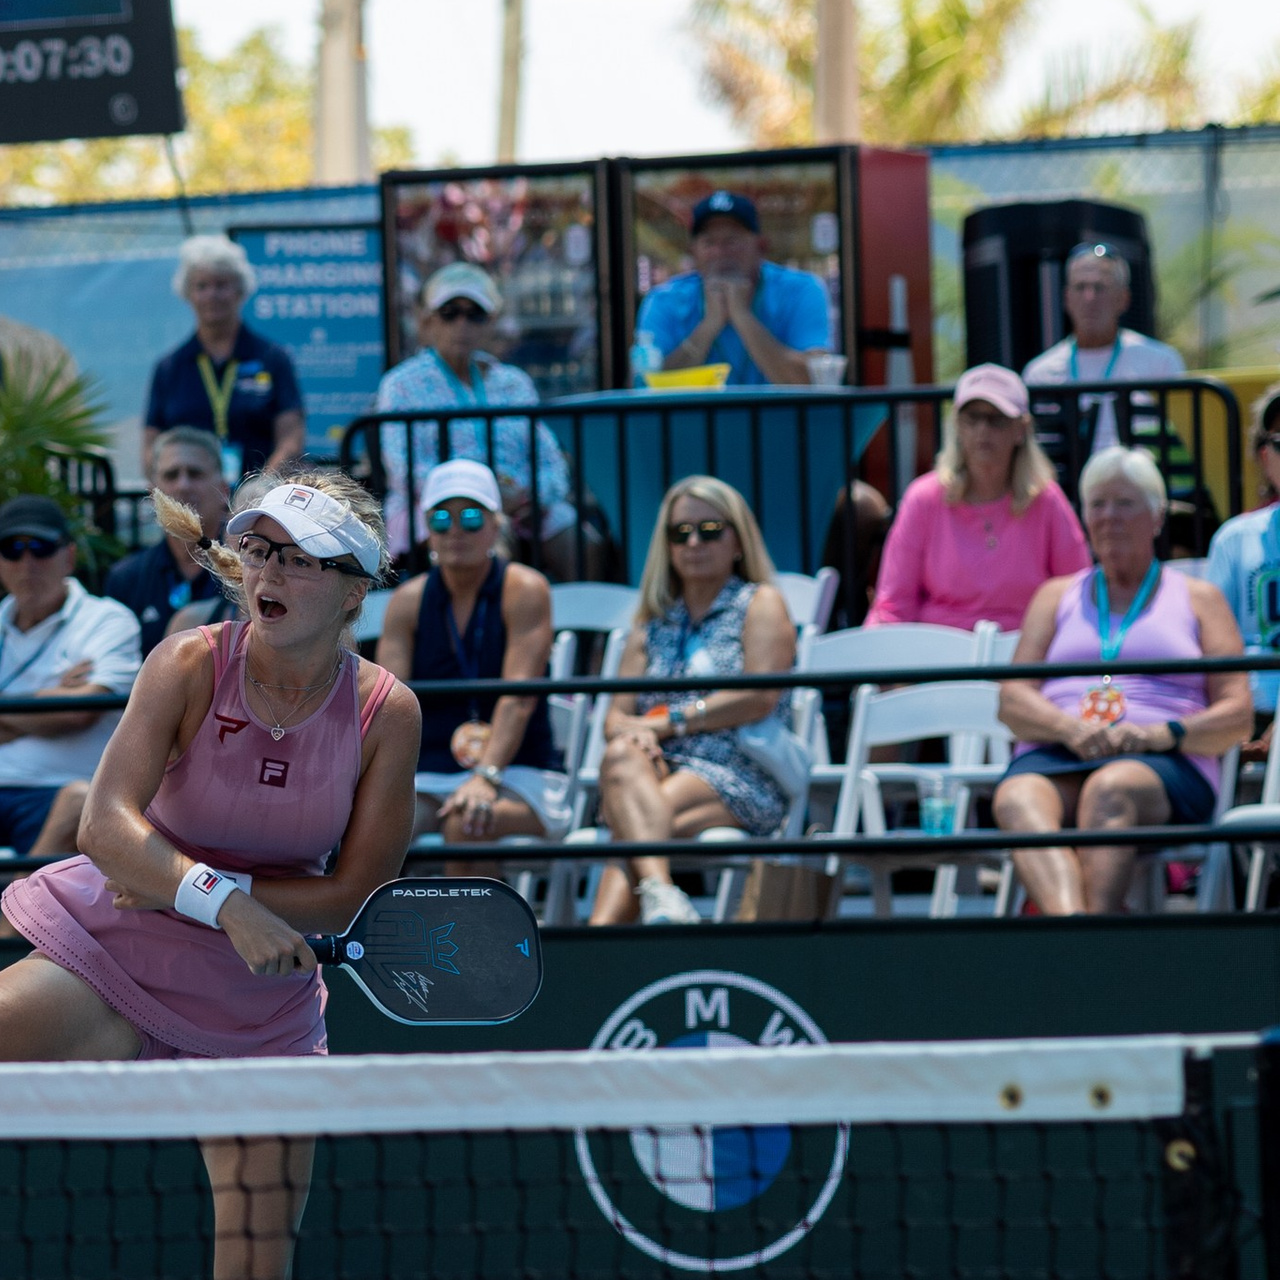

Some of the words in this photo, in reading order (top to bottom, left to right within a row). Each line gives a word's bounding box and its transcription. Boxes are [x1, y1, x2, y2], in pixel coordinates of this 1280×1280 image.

[263, 231, 367, 256] PHONE
[253, 293, 380, 319] STATION
[392, 888, 493, 898] PADDLETEK
